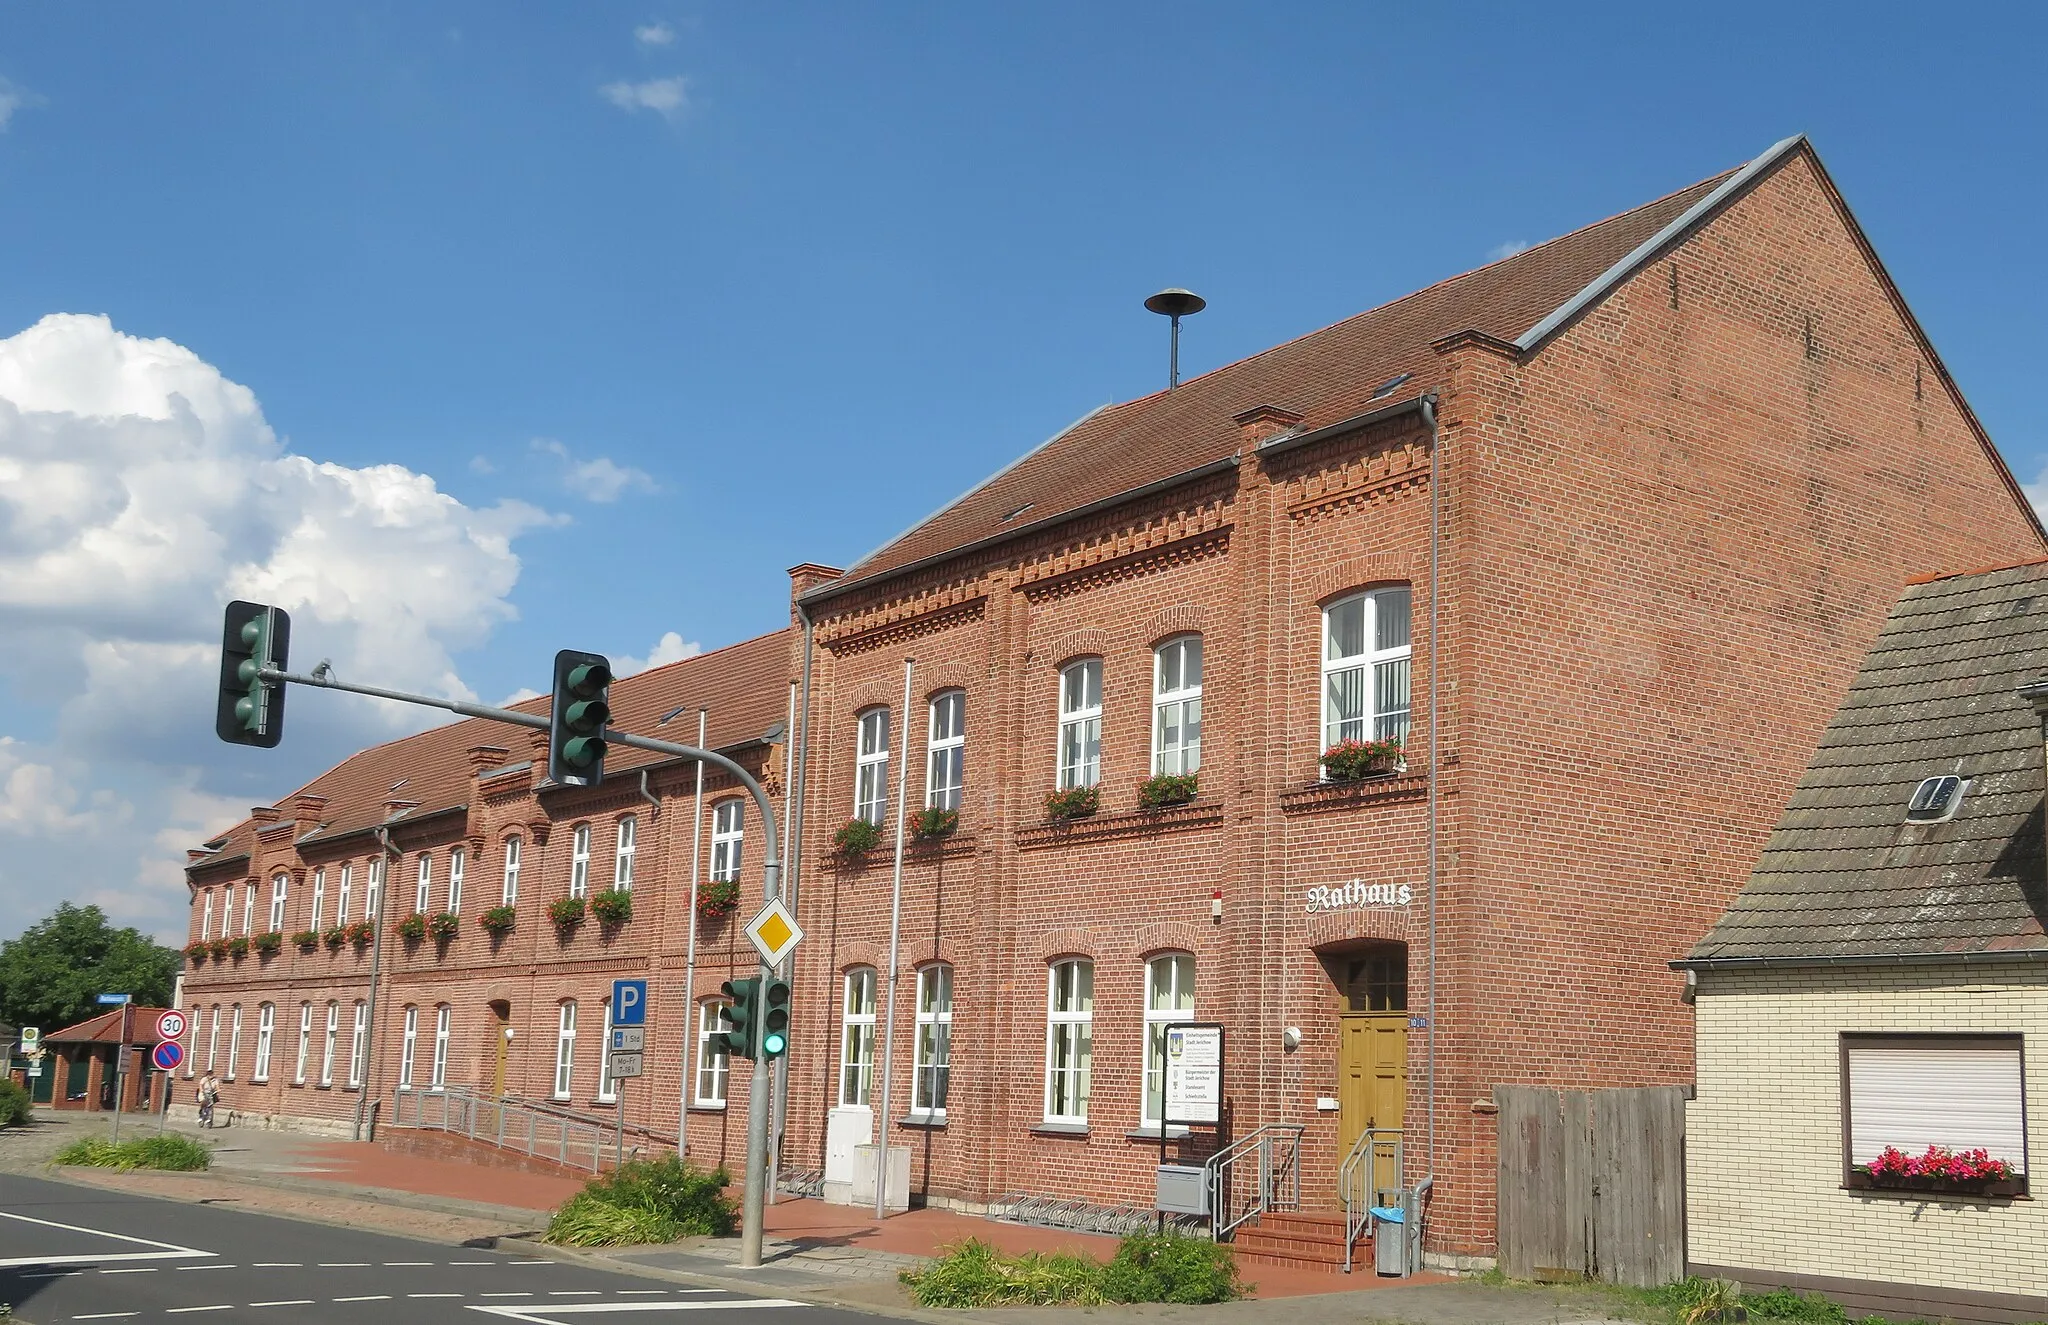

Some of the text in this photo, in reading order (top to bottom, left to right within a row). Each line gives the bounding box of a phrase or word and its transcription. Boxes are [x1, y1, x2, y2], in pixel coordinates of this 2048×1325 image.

[1306, 878, 1412, 914] Rathaus
[620, 986, 639, 1020] P
[163, 1018, 181, 1032] 30
[617, 1056, 636, 1065] Mo-Fr
